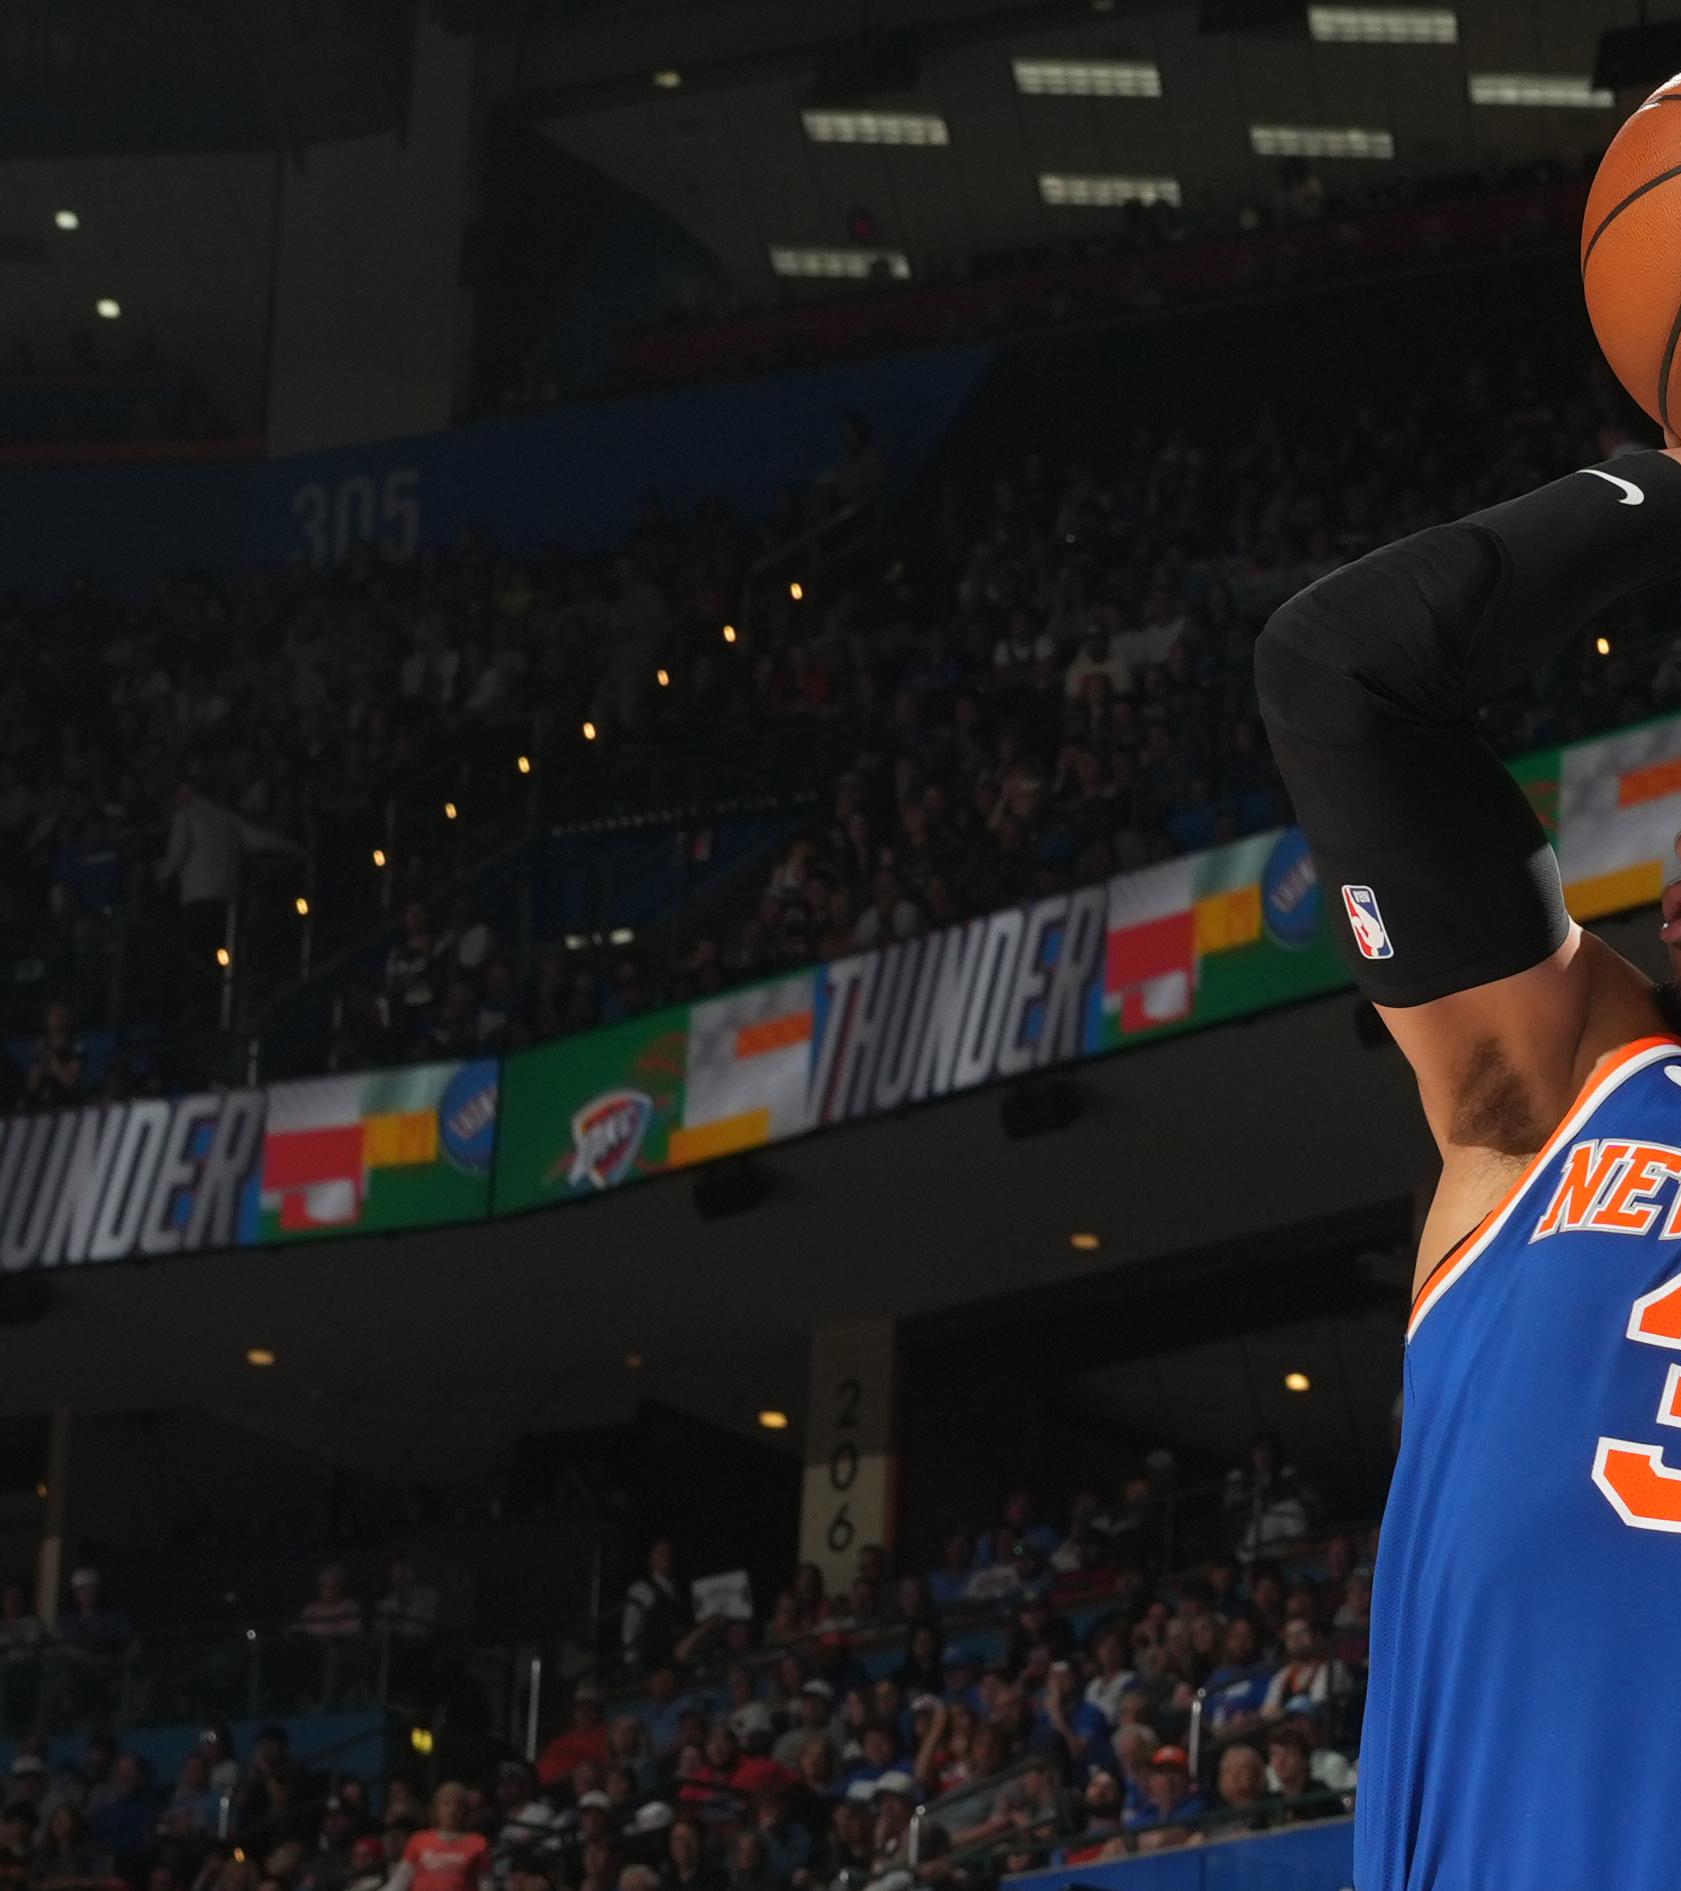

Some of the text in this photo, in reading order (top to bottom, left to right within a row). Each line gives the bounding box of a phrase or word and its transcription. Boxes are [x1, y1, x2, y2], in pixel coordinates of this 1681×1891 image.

[293, 470, 419, 567] 305
[804, 884, 1107, 1133] THUNDER
[0, 1092, 264, 1273] UNDER
[827, 1377, 862, 1553] 206
